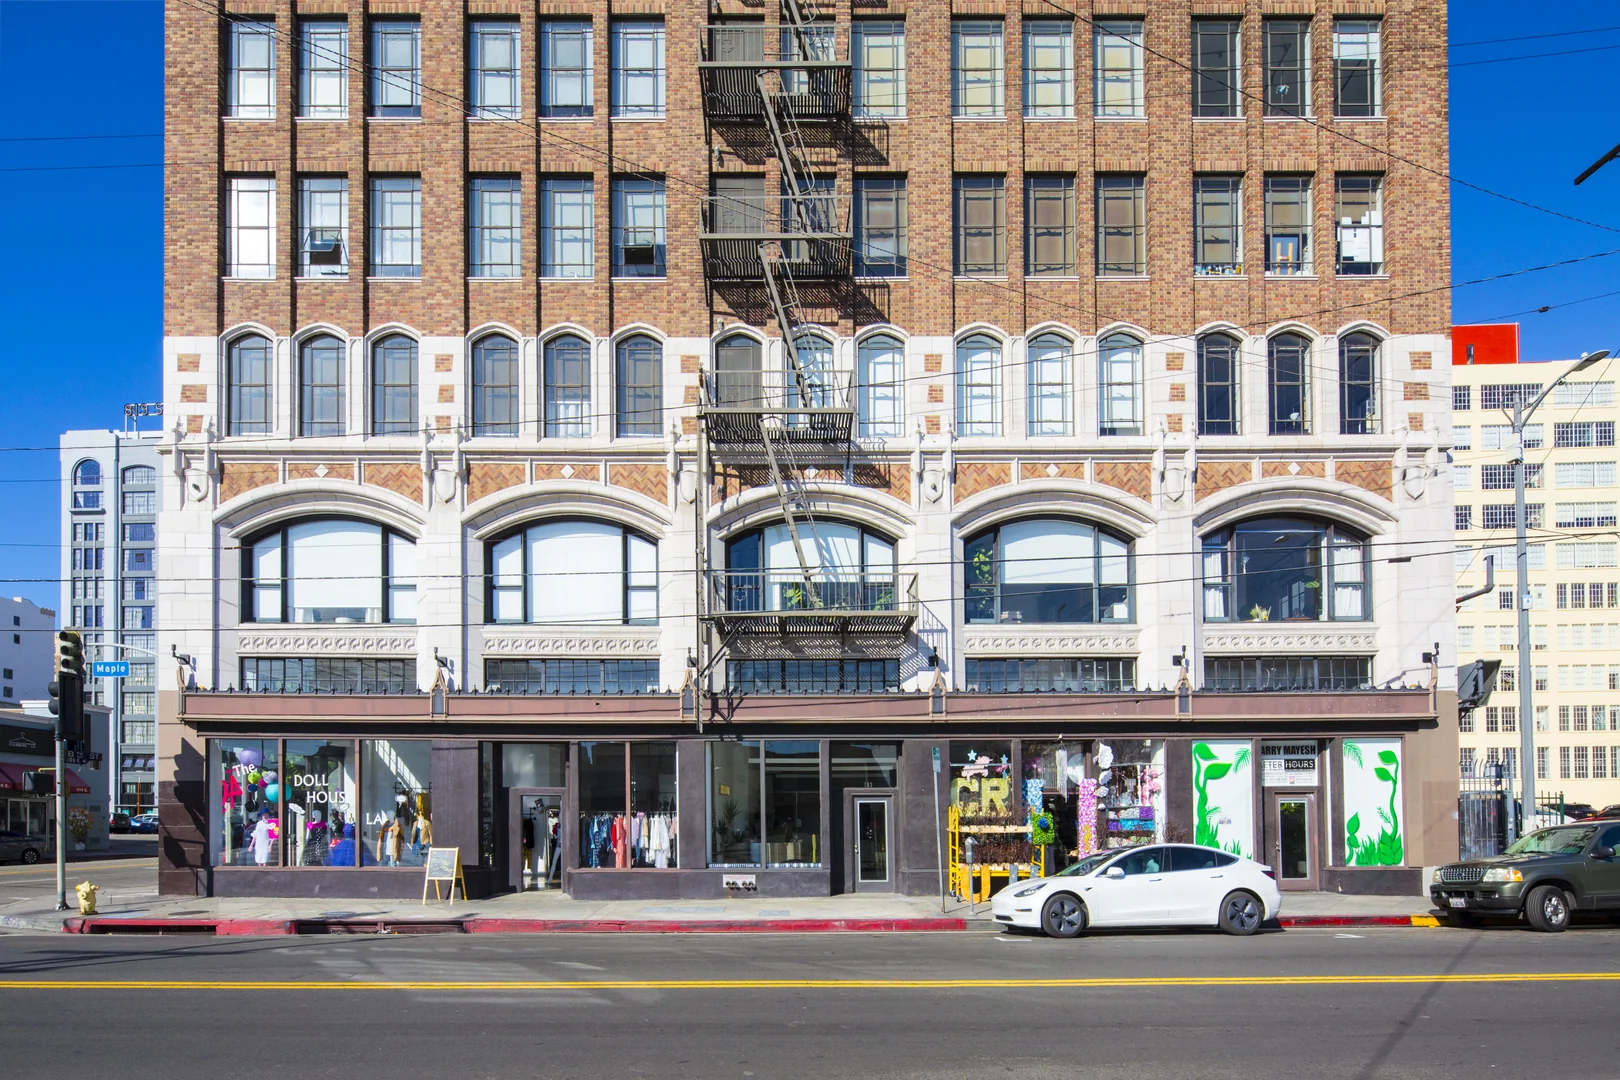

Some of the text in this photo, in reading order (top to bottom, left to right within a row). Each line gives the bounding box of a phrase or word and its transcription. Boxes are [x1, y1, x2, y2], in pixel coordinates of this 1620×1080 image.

[124, 403, 148, 416] 819
[96, 664, 126, 674] Maple
[1261, 745, 1316, 756] ARRY MAYESH
[232, 763, 257, 777] The
[1285, 760, 1314, 769] HOURS
[293, 774, 329, 787] DOLL
[306, 791, 345, 803] HOUS
[366, 813, 382, 825] LA
